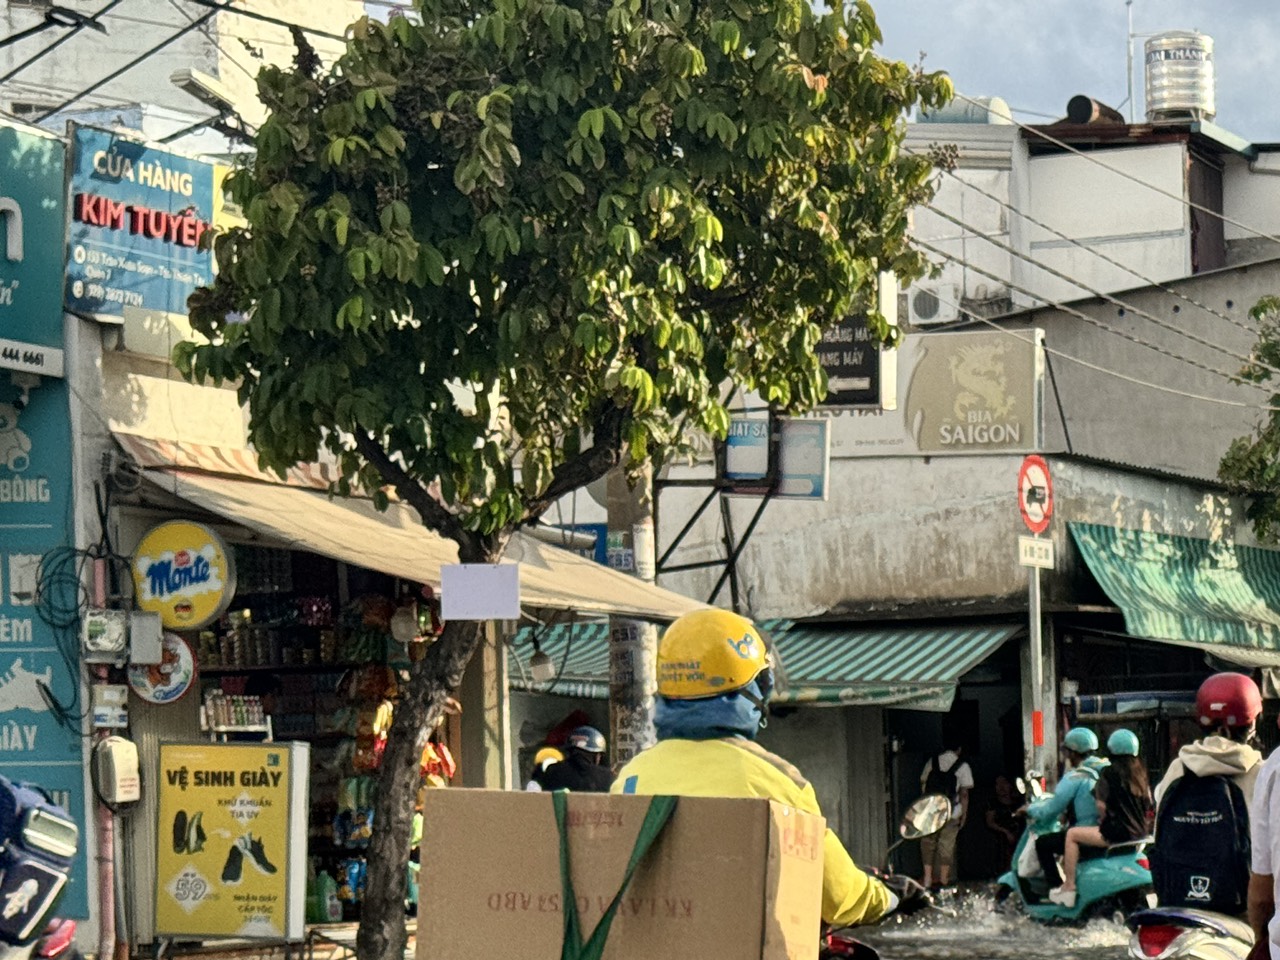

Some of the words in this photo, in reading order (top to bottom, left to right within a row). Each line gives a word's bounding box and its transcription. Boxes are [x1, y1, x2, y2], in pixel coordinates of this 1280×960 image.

[139, 160, 193, 196] HÀNG
[81, 193, 125, 231] KIM
[967, 410, 992, 424] BIA
[939, 423, 1020, 445] SAIGON
[146, 555, 211, 597] Monte
[166, 765, 189, 791] VỆ
[193, 770, 235, 787] SINH
[240, 765, 282, 787] GIÀY
[174, 878, 207, 901] 59
